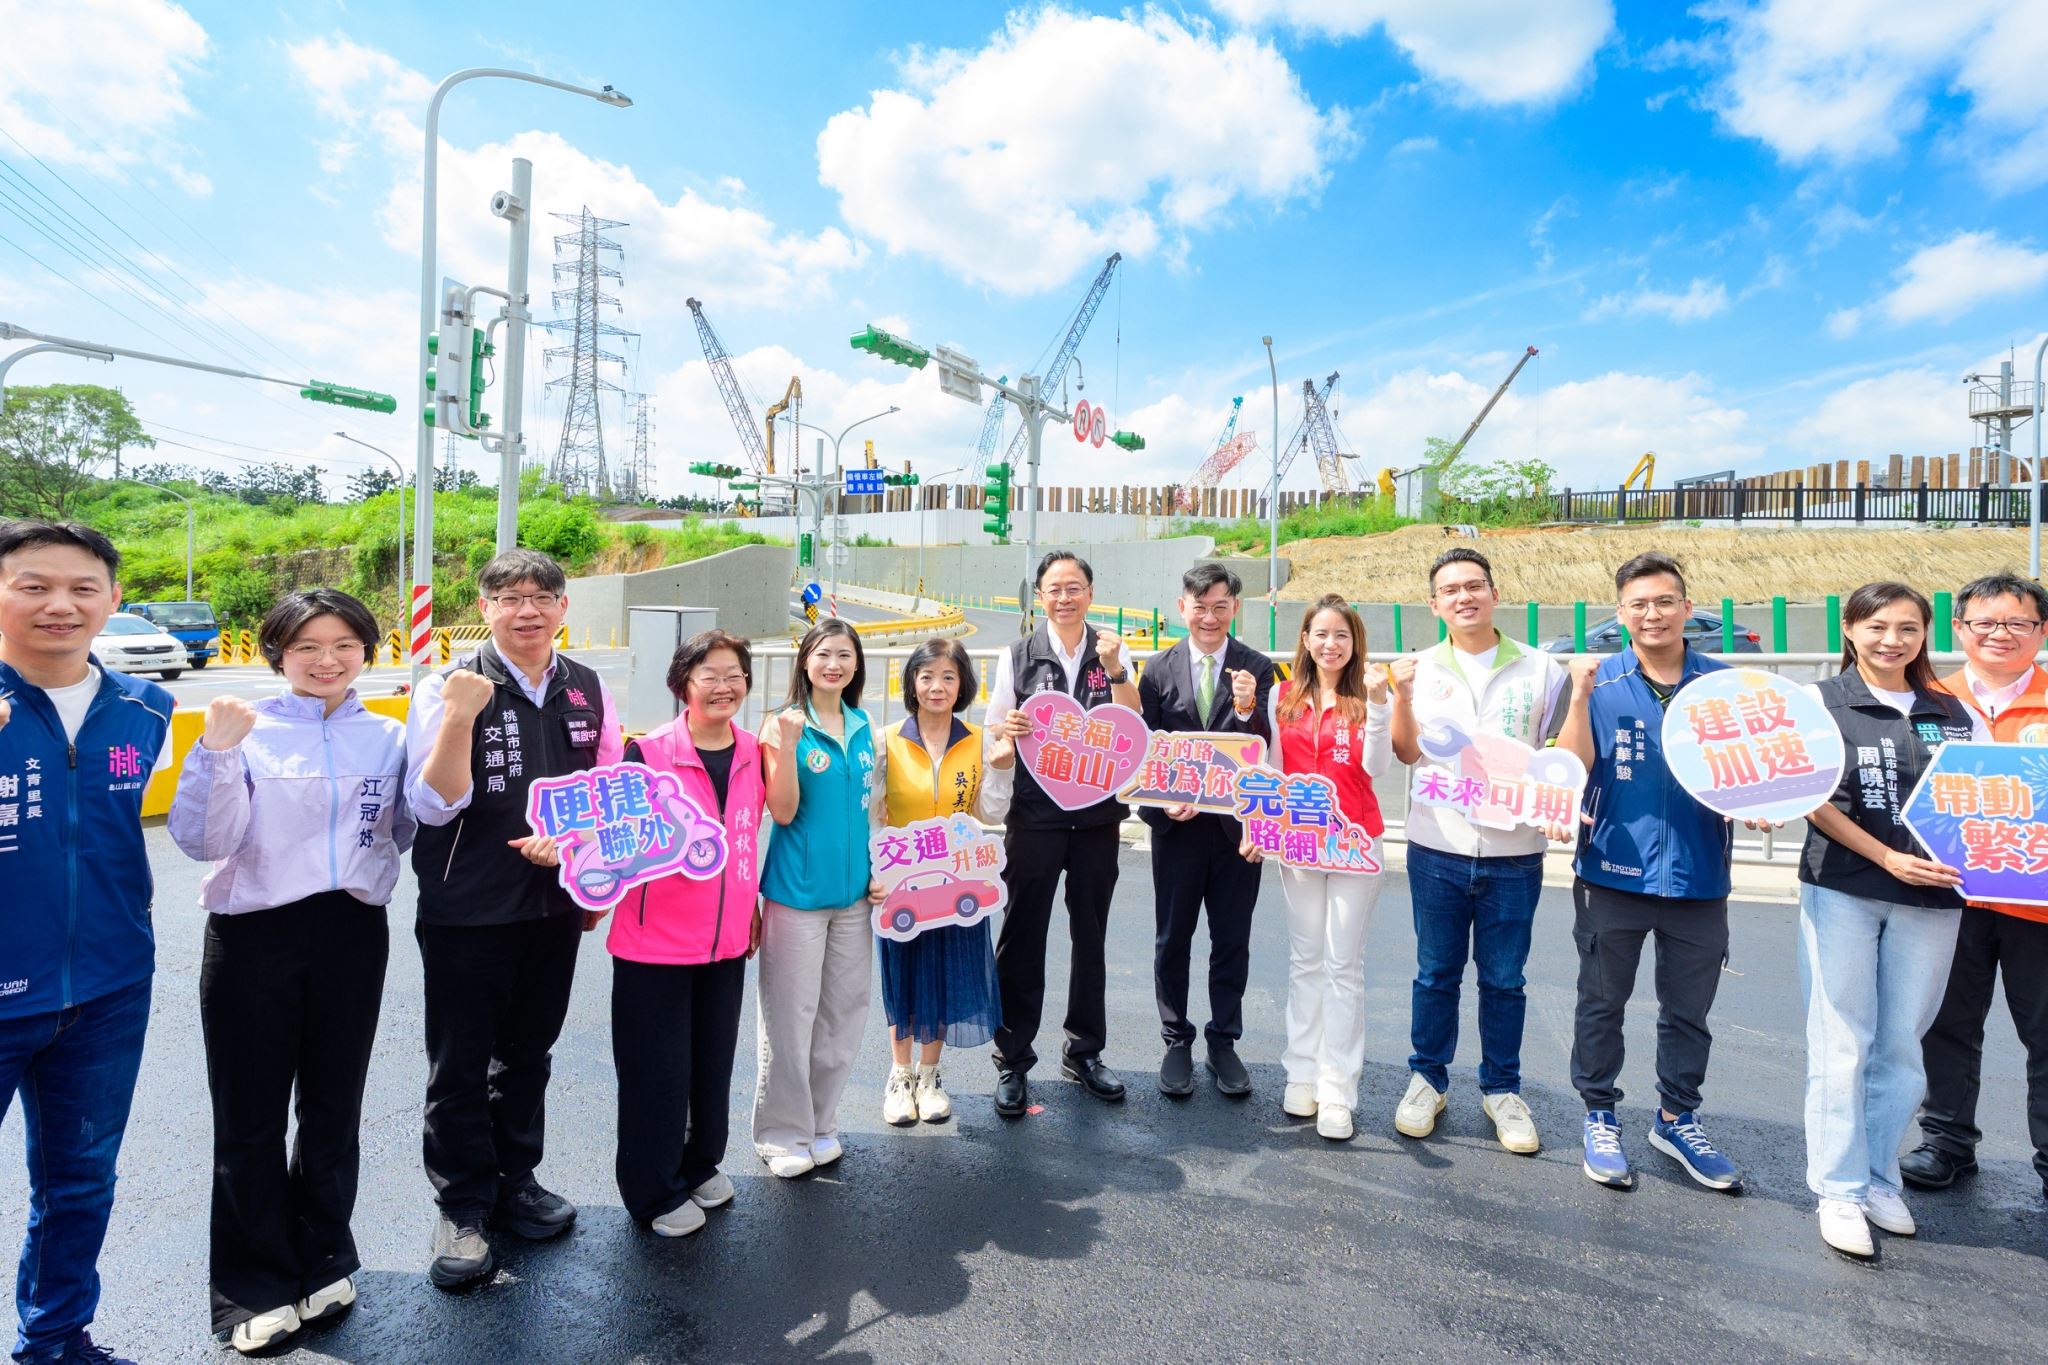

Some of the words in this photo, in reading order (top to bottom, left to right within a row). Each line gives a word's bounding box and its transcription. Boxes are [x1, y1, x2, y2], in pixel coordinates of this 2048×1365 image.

[1052, 712, 1115, 750] 幸福
[1683, 688, 1795, 744] 建設
[484, 726, 506, 793] 交通局
[502, 709, 523, 778] 桃園市政府
[1035, 742, 1116, 792] 龜山
[1703, 732, 1815, 789] 加速
[25, 758, 42, 819] 文青里長
[539, 772, 651, 836] 便捷
[1238, 773, 1332, 827] 完善
[1418, 772, 1574, 826] 未來可期
[1932, 774, 2033, 817] 帶動
[597, 814, 674, 861] 聯外
[877, 825, 949, 872] 交通
[952, 843, 998, 873] 升級
[1250, 818, 1318, 864] 路網
